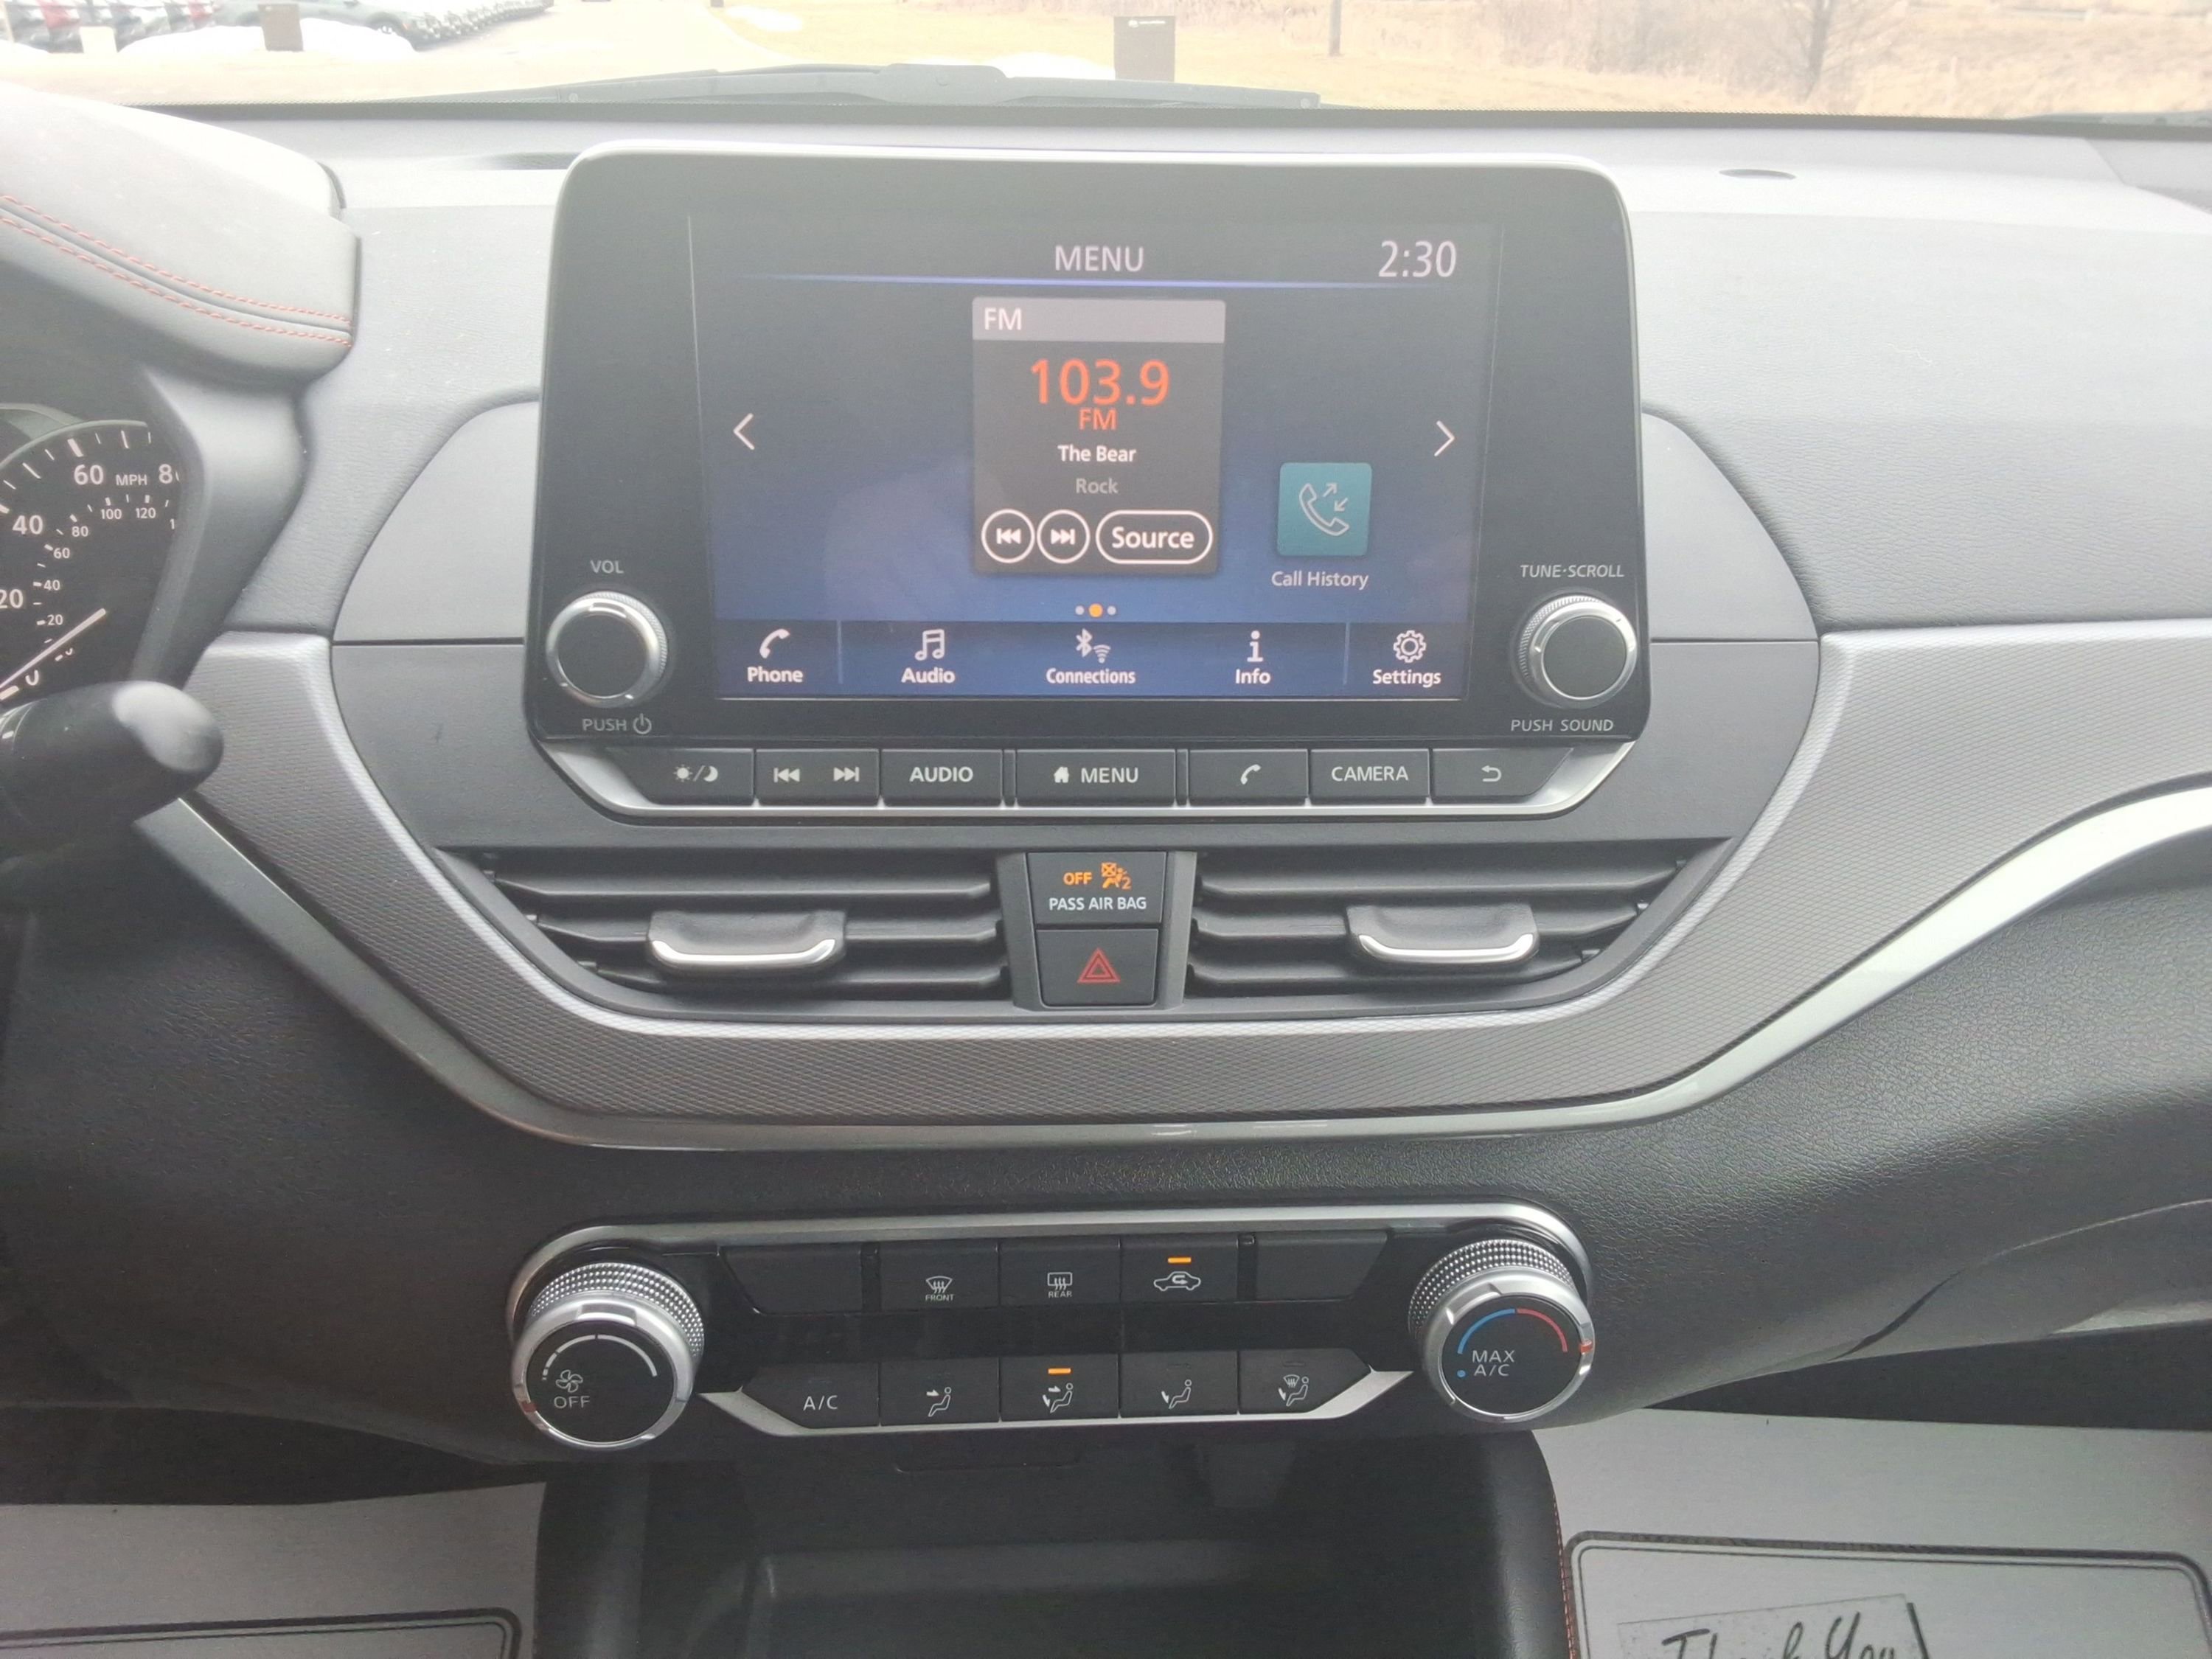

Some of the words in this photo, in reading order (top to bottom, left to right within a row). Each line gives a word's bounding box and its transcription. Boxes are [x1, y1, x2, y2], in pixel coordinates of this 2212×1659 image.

[1054, 246, 1145, 272] MENU
[1378, 240, 1457, 279] 2:30
[984, 307, 1023, 331] FM
[1031, 358, 1171, 406] 103.9
[1079, 408, 1117, 431] FM
[1057, 444, 1092, 462] The
[1096, 445, 1137, 462] Bear
[74, 464, 105, 485] 60
[115, 473, 147, 486] MPH
[159, 463, 180, 484] 8
[1075, 477, 1119, 495] Rock
[100, 507, 122, 520] 100
[136, 507, 156, 519] 120
[12, 514, 44, 535] 40
[72, 525, 89, 538] 80
[1111, 526, 1195, 549] Source
[53, 547, 71, 559] 60
[590, 560, 625, 575] VOL
[44, 580, 60, 591] 40
[1271, 570, 1302, 587] Call
[1307, 570, 1369, 590] History
[46, 613, 63, 626] 20
[746, 666, 804, 684] Phone
[901, 667, 956, 685] Audio
[1046, 667, 1136, 685] Connections
[1235, 668, 1272, 686] Info
[1372, 669, 1442, 688] Settings
[582, 717, 627, 733] PUSH
[1510, 718, 1554, 732] PUSH
[1559, 718, 1614, 732] SOUND
[908, 765, 974, 784] AUDIO
[1080, 767, 1140, 784] MENU
[1330, 765, 1409, 782] CAMERA
[1062, 872, 1093, 886] OFF
[1048, 897, 1085, 911] PASS
[1088, 897, 1113, 910] AIR
[1117, 896, 1147, 910] BAG
[925, 1293, 955, 1301] FRONT
[1047, 1290, 1073, 1298] REAR
[1471, 1349, 1515, 1364] MAX
[1472, 1363, 1511, 1377] A/C
[554, 1395, 591, 1409] OFF
[803, 1395, 838, 1411] A/C
